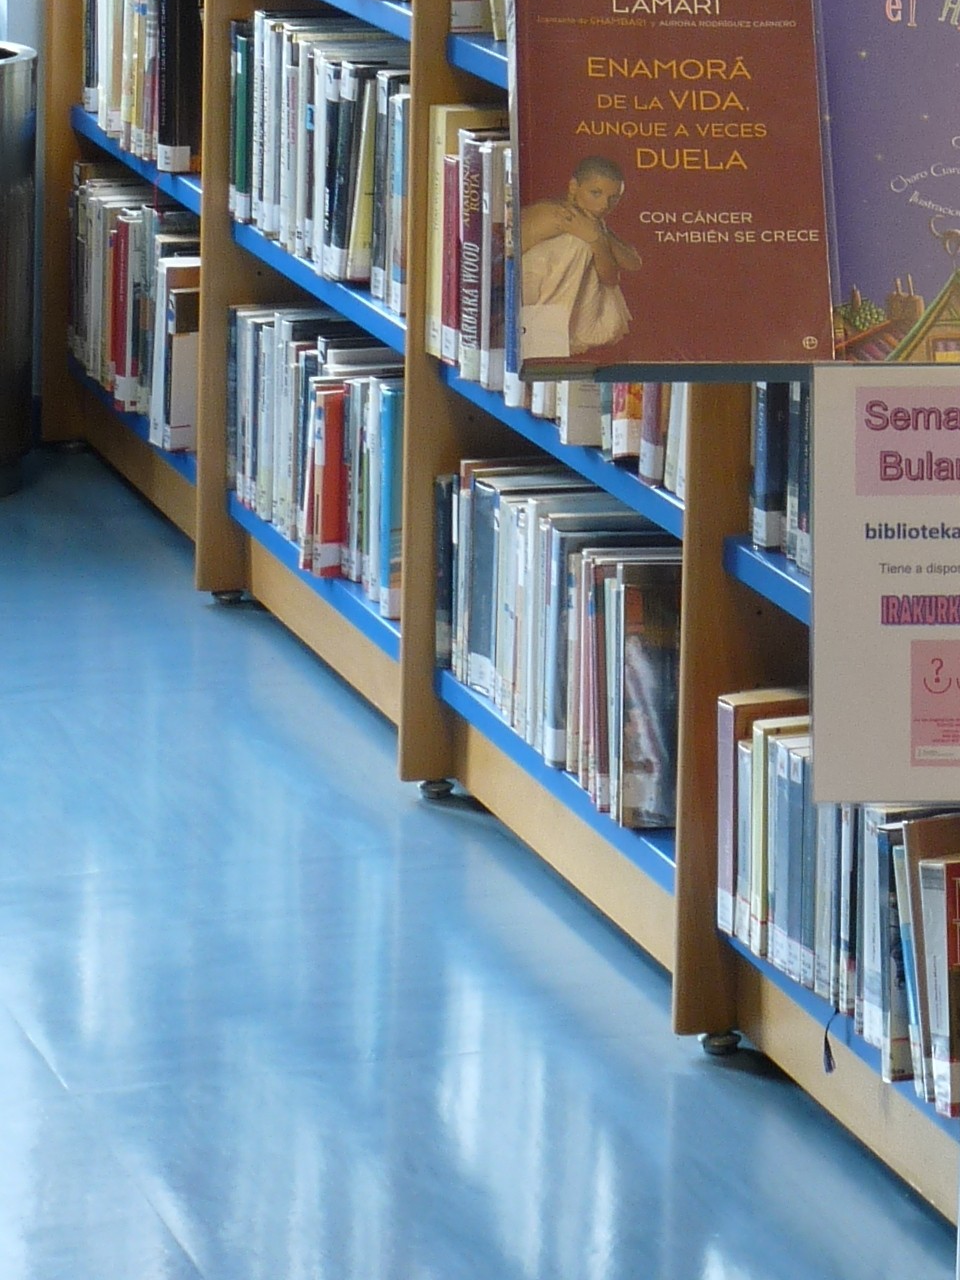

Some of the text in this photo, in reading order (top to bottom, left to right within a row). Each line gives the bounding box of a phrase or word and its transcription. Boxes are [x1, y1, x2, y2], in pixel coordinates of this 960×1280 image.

[659, 19, 797, 29] AURORA RODRÍGUEZ CARNERO
[586, 56, 752, 81] ENAMORÁ
[597, 94, 627, 110] DE
[634, 95, 664, 111] LA
[575, 121, 768, 139] AUNQUE A VECES
[635, 147, 748, 171] DUELA
[470, 173, 480, 212] ROTA
[639, 210, 753, 224] CON CÁNCER
[654, 228, 820, 243] TAMBIÉN SE CRECE
[462, 241, 480, 283] WOOD
[878, 562, 912, 574] Tiene
